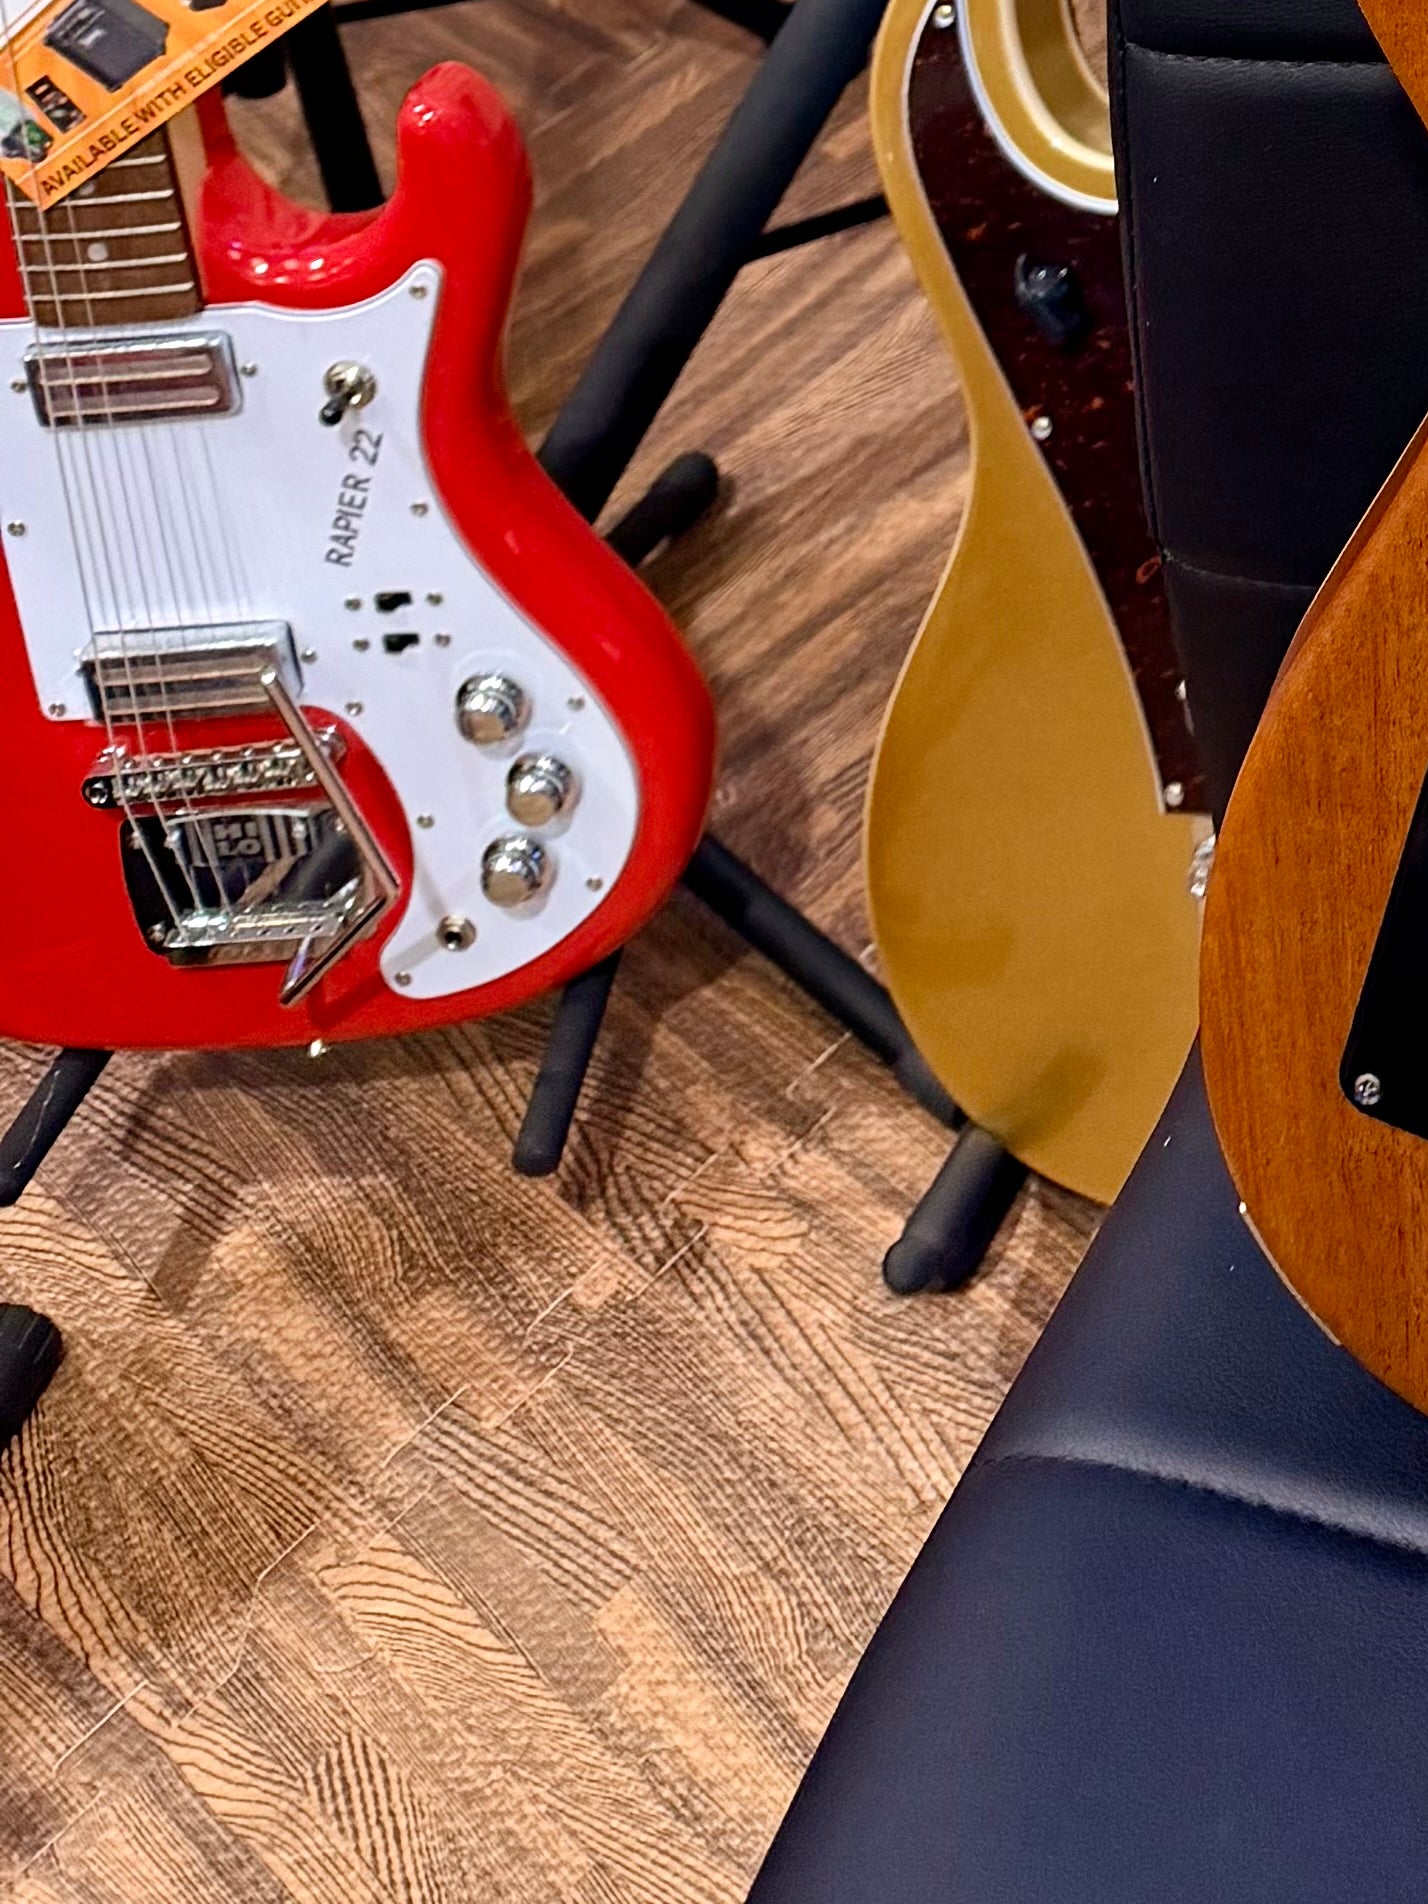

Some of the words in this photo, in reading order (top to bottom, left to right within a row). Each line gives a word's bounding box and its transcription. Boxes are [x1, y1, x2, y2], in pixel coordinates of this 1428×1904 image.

[40, 118, 140, 196] AVAILABLE
[133, 83, 188, 126] WITH
[183, 22, 270, 88] ELIGIBLE
[348, 428, 384, 467] 22
[324, 473, 373, 568] RAPIER
